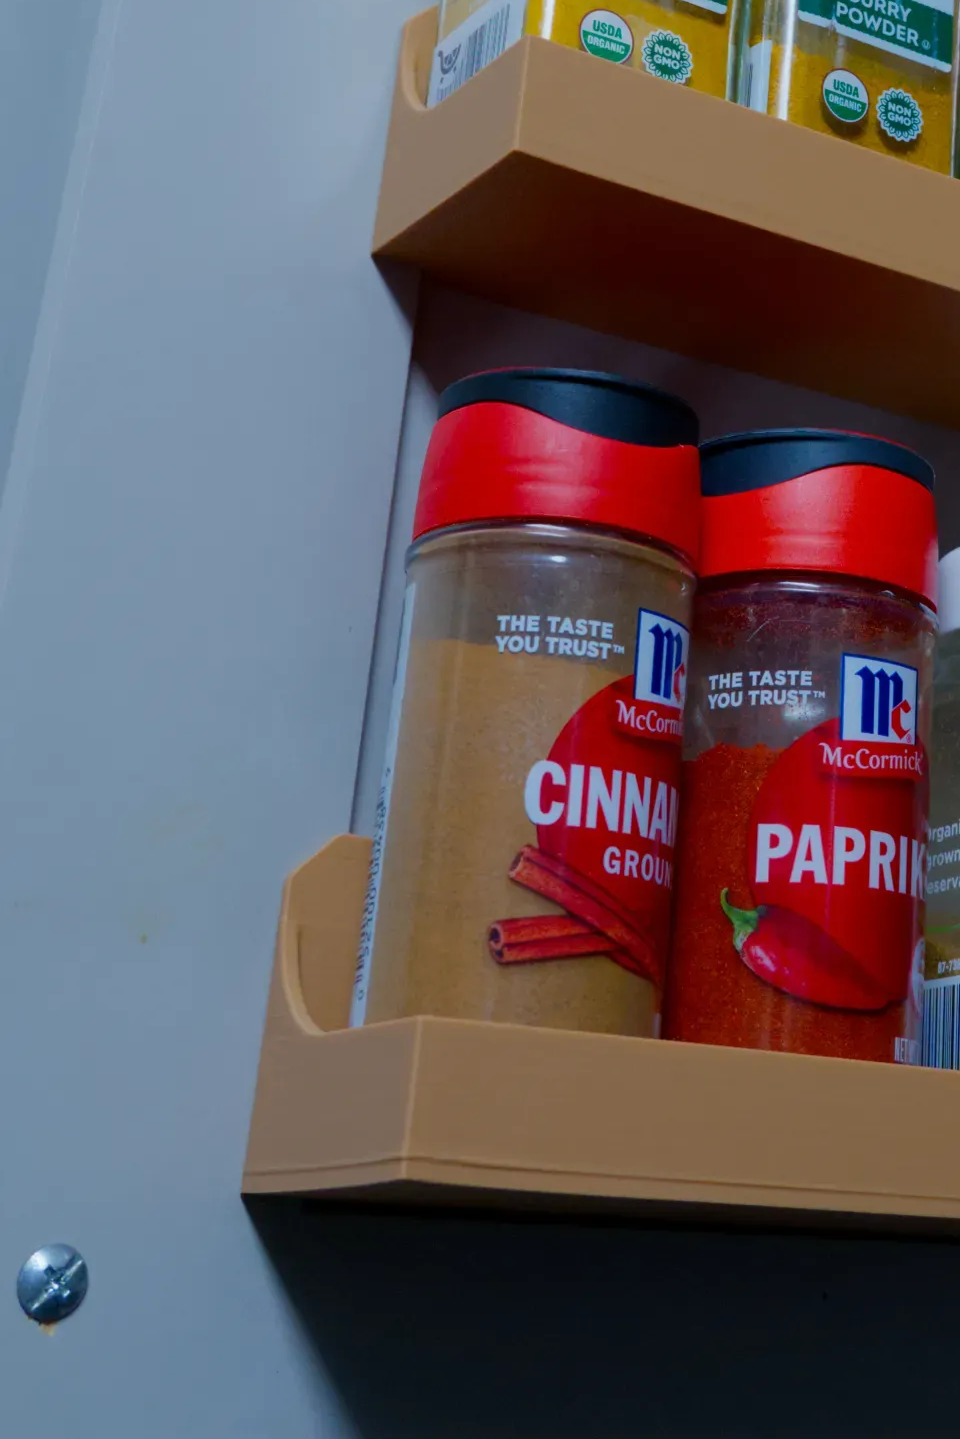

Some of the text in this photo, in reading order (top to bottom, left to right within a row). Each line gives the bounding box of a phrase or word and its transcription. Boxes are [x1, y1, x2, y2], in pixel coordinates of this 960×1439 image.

[592, 19, 622, 40] USDA
[835, 2, 919, 47] POWDER
[587, 34, 625, 54] ORGANIC
[654, 44, 681, 60] NON
[653, 55, 680, 70] GMO
[833, 78, 860, 99] USDA
[828, 93, 862, 113] ORGANIC
[887, 101, 913, 116] NON
[887, 112, 912, 127] GMO
[497, 614, 614, 640] THE TASTE
[495, 635, 540, 655] YOU
[708, 670, 813, 691] THE TASTE
[708, 690, 744, 710] YOU
[616, 699, 683, 736] McCorm
[818, 742, 922, 775] McCormick
[524, 759, 679, 848] CINNA
[603, 846, 673, 891] GROUN
[755, 823, 926, 901] PAPRIK
